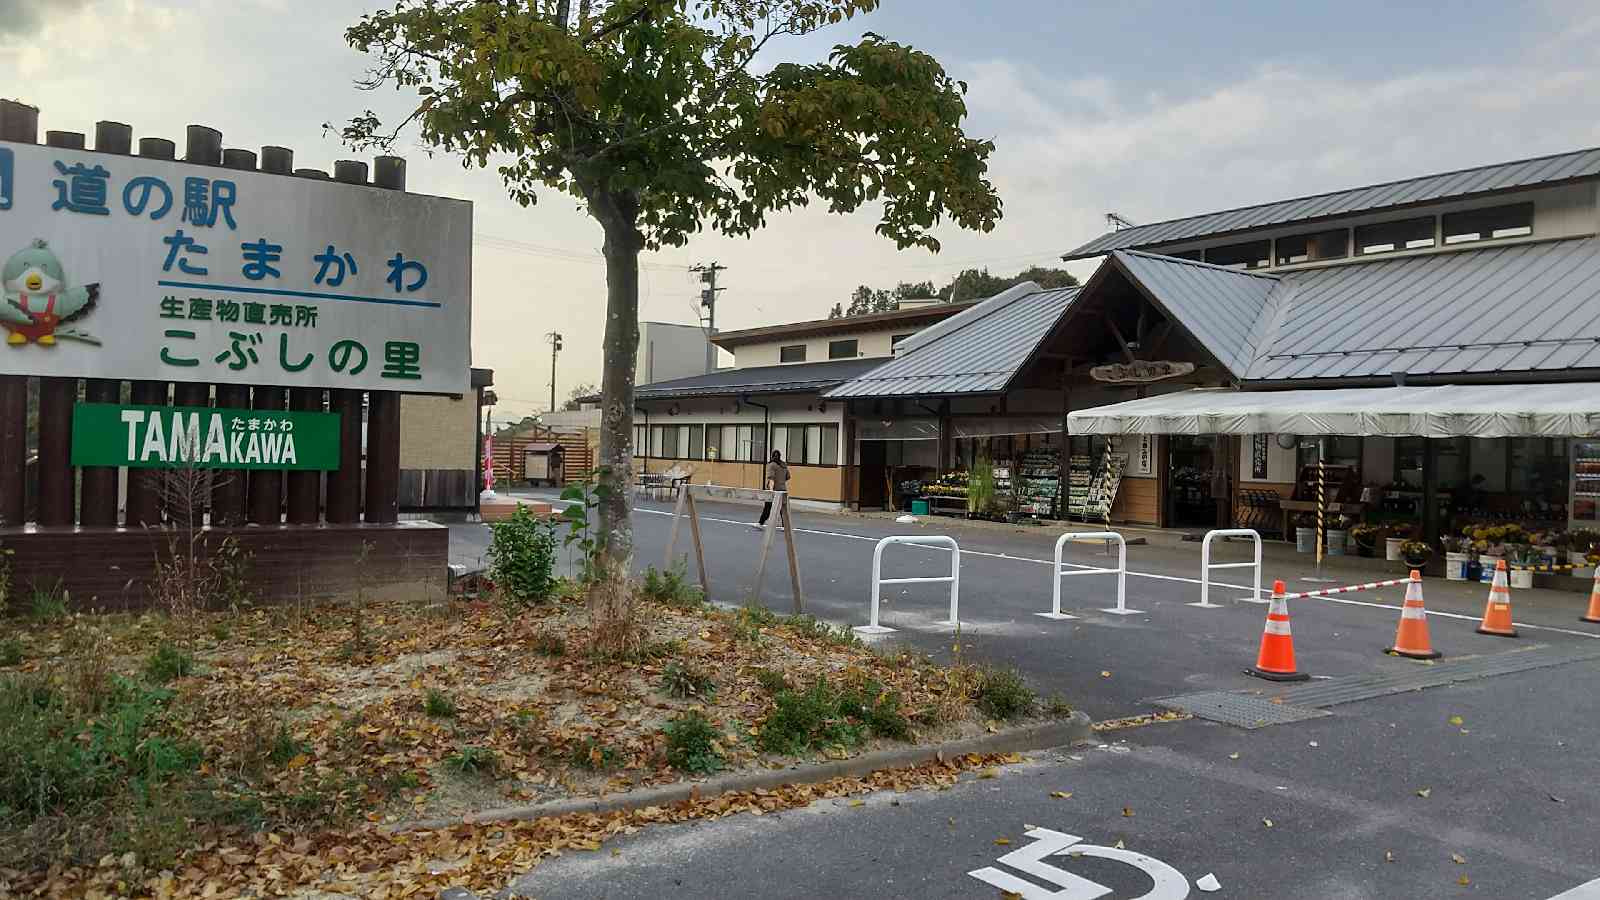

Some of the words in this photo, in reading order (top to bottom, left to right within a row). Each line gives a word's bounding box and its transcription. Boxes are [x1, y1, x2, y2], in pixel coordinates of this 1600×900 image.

[52, 160, 237, 230] 道の駅
[163, 229, 428, 292] たまかわ
[159, 296, 319, 328] 生産物直売所
[160, 329, 422, 380] こぶしの里
[231, 416, 294, 431] たまかわ
